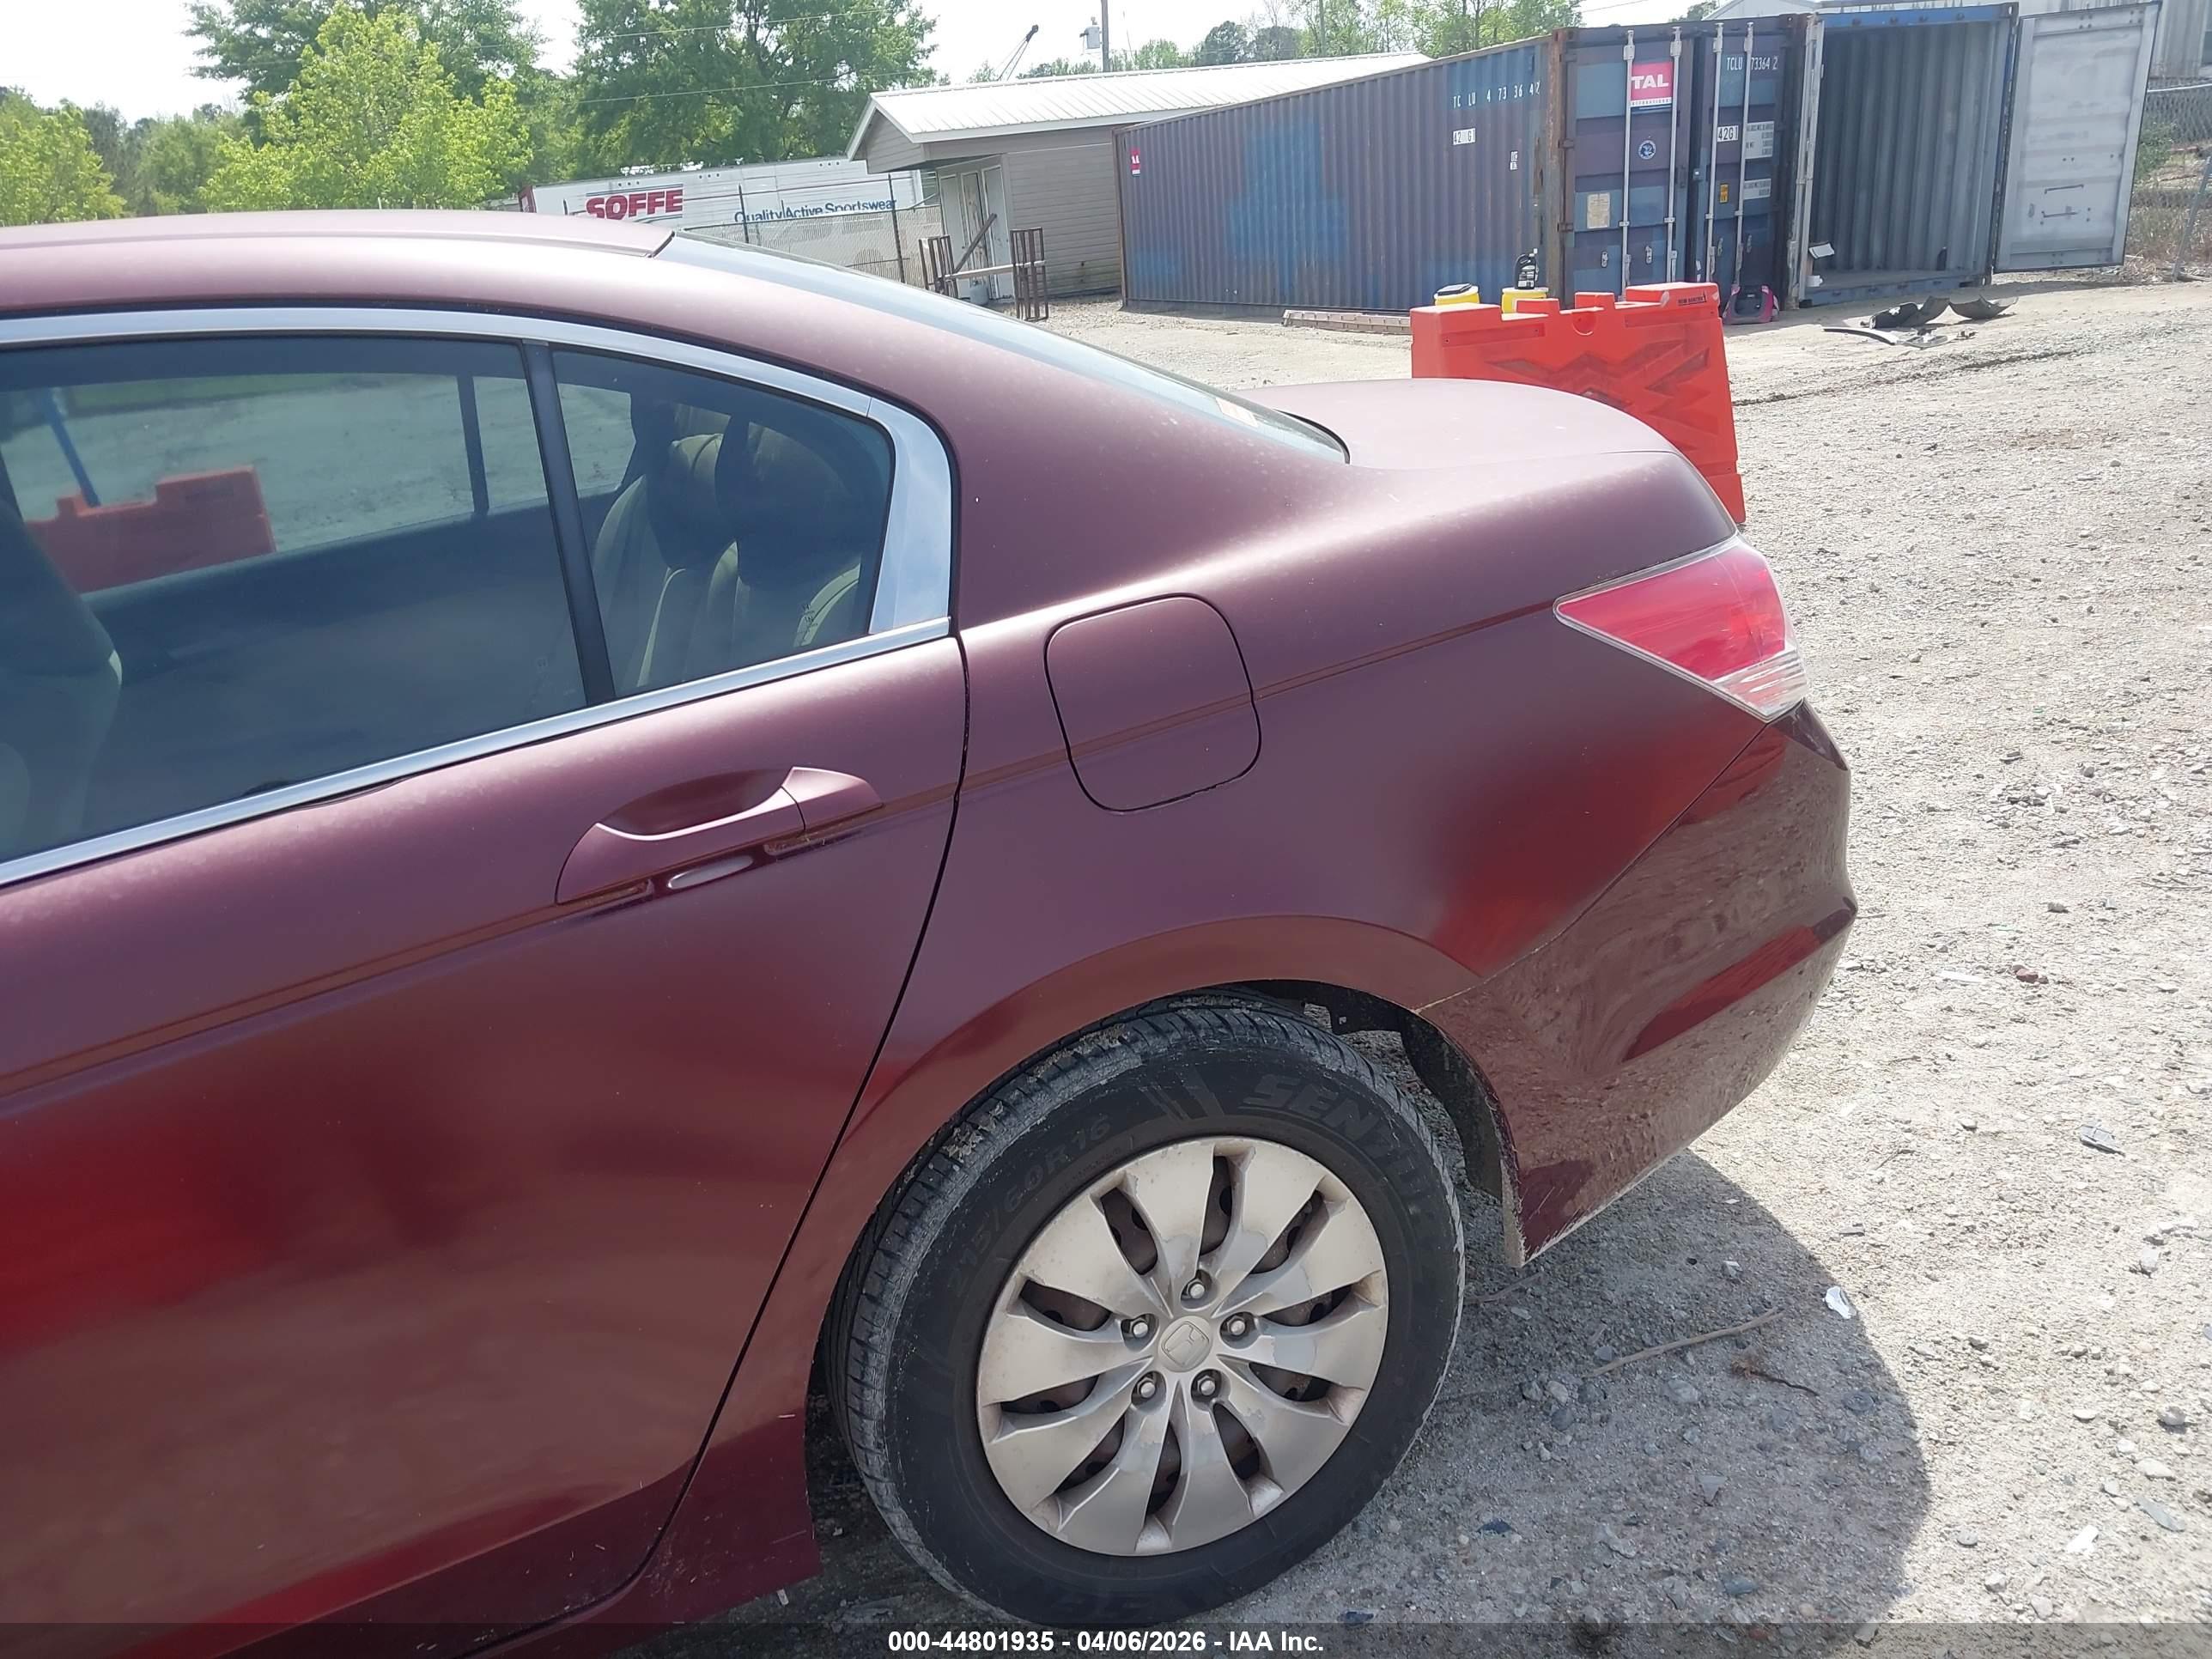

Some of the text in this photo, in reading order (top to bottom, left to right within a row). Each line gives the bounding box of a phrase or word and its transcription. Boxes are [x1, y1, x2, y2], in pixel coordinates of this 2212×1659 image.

[1726, 56, 1743, 71] TCLU
[1631, 74, 1669, 89] TAL
[1717, 125, 1739, 142] 42G1
[586, 189, 684, 221] SOFFE
[824, 198, 896, 214] Sportswear
